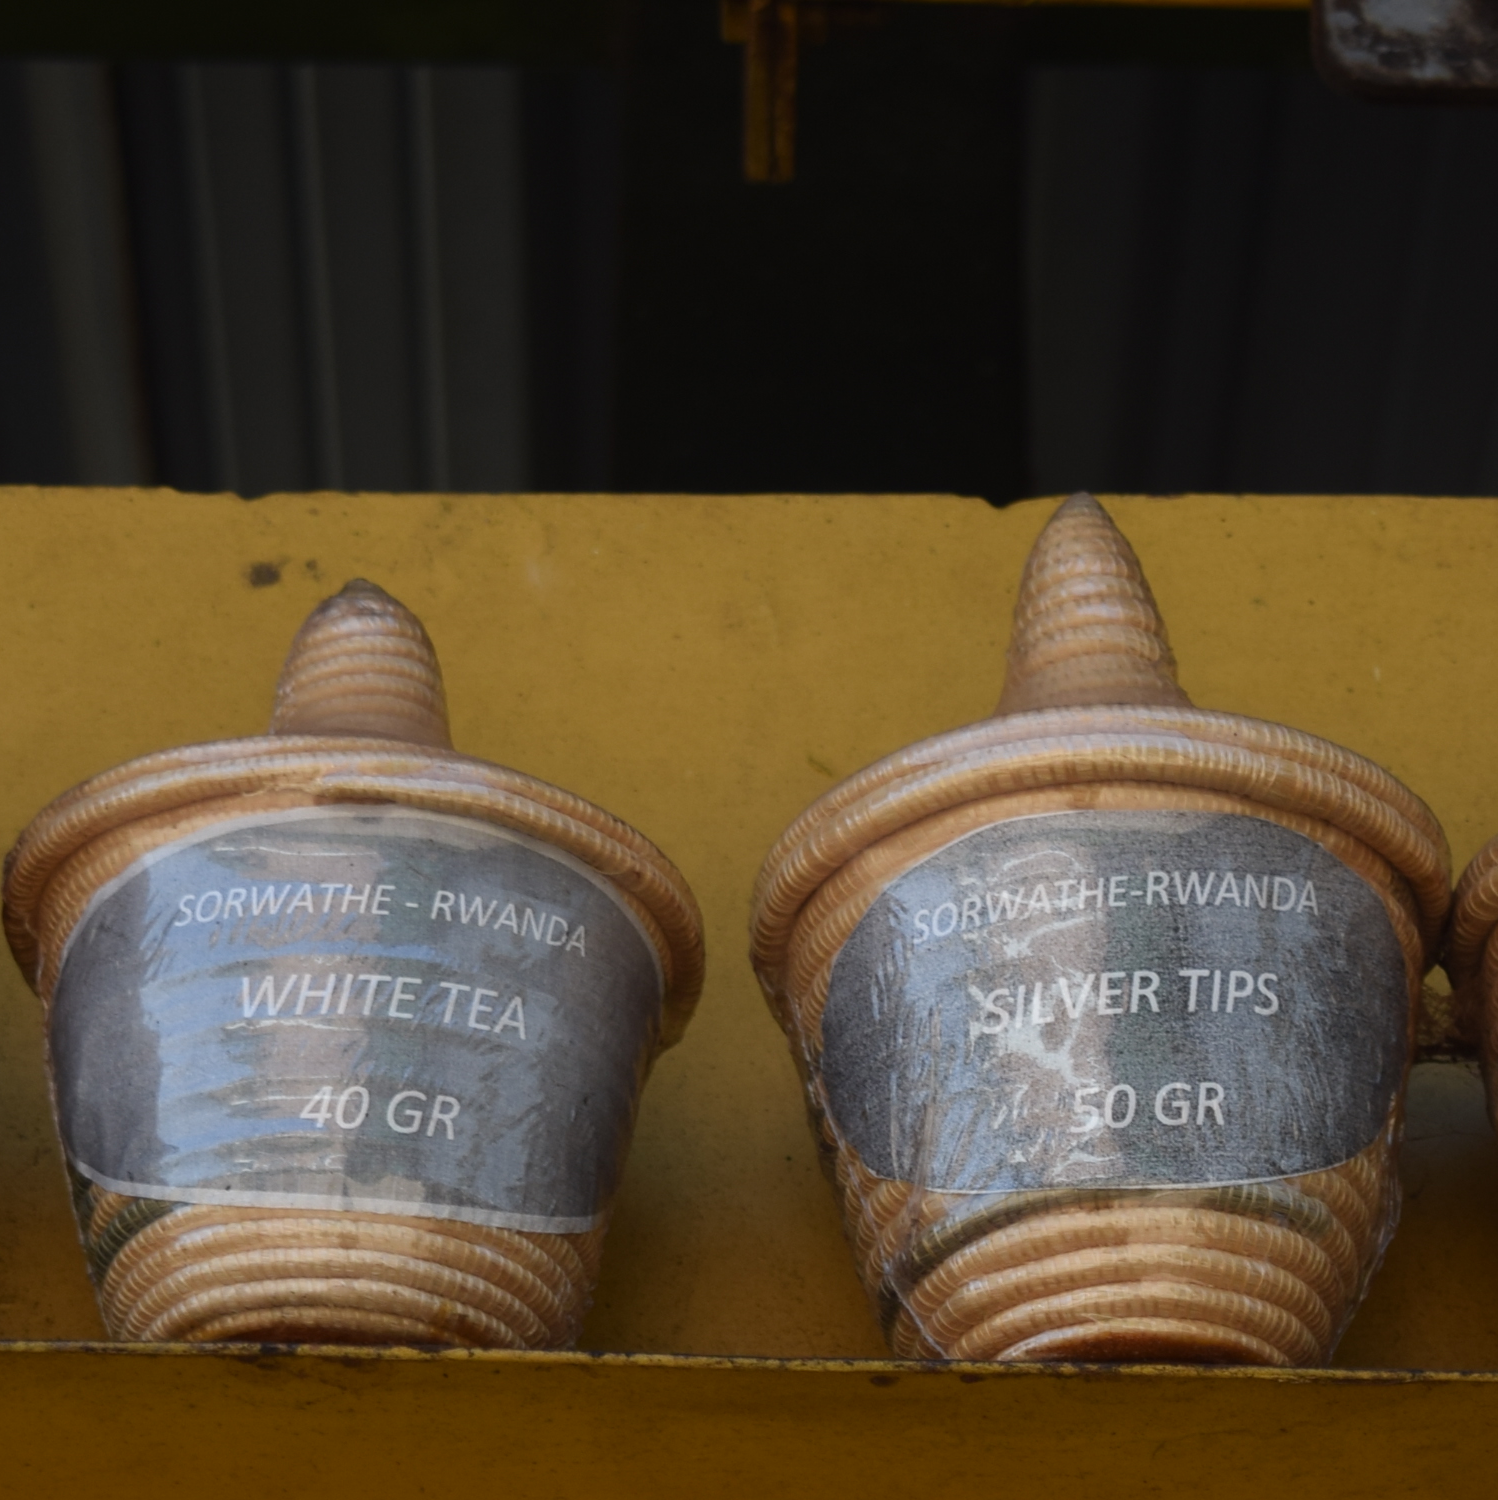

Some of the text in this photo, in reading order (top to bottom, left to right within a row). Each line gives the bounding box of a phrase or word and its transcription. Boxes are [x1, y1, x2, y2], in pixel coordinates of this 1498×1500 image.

[173, 882, 396, 927] SORWATHE
[431, 890, 588, 957] RWANDA
[241, 975, 527, 1040] WHITE TEA
[978, 969, 1280, 1035] SILVER TIPS
[299, 1083, 461, 1140] 40 GR
[1069, 1082, 1226, 1133] 50 GR
